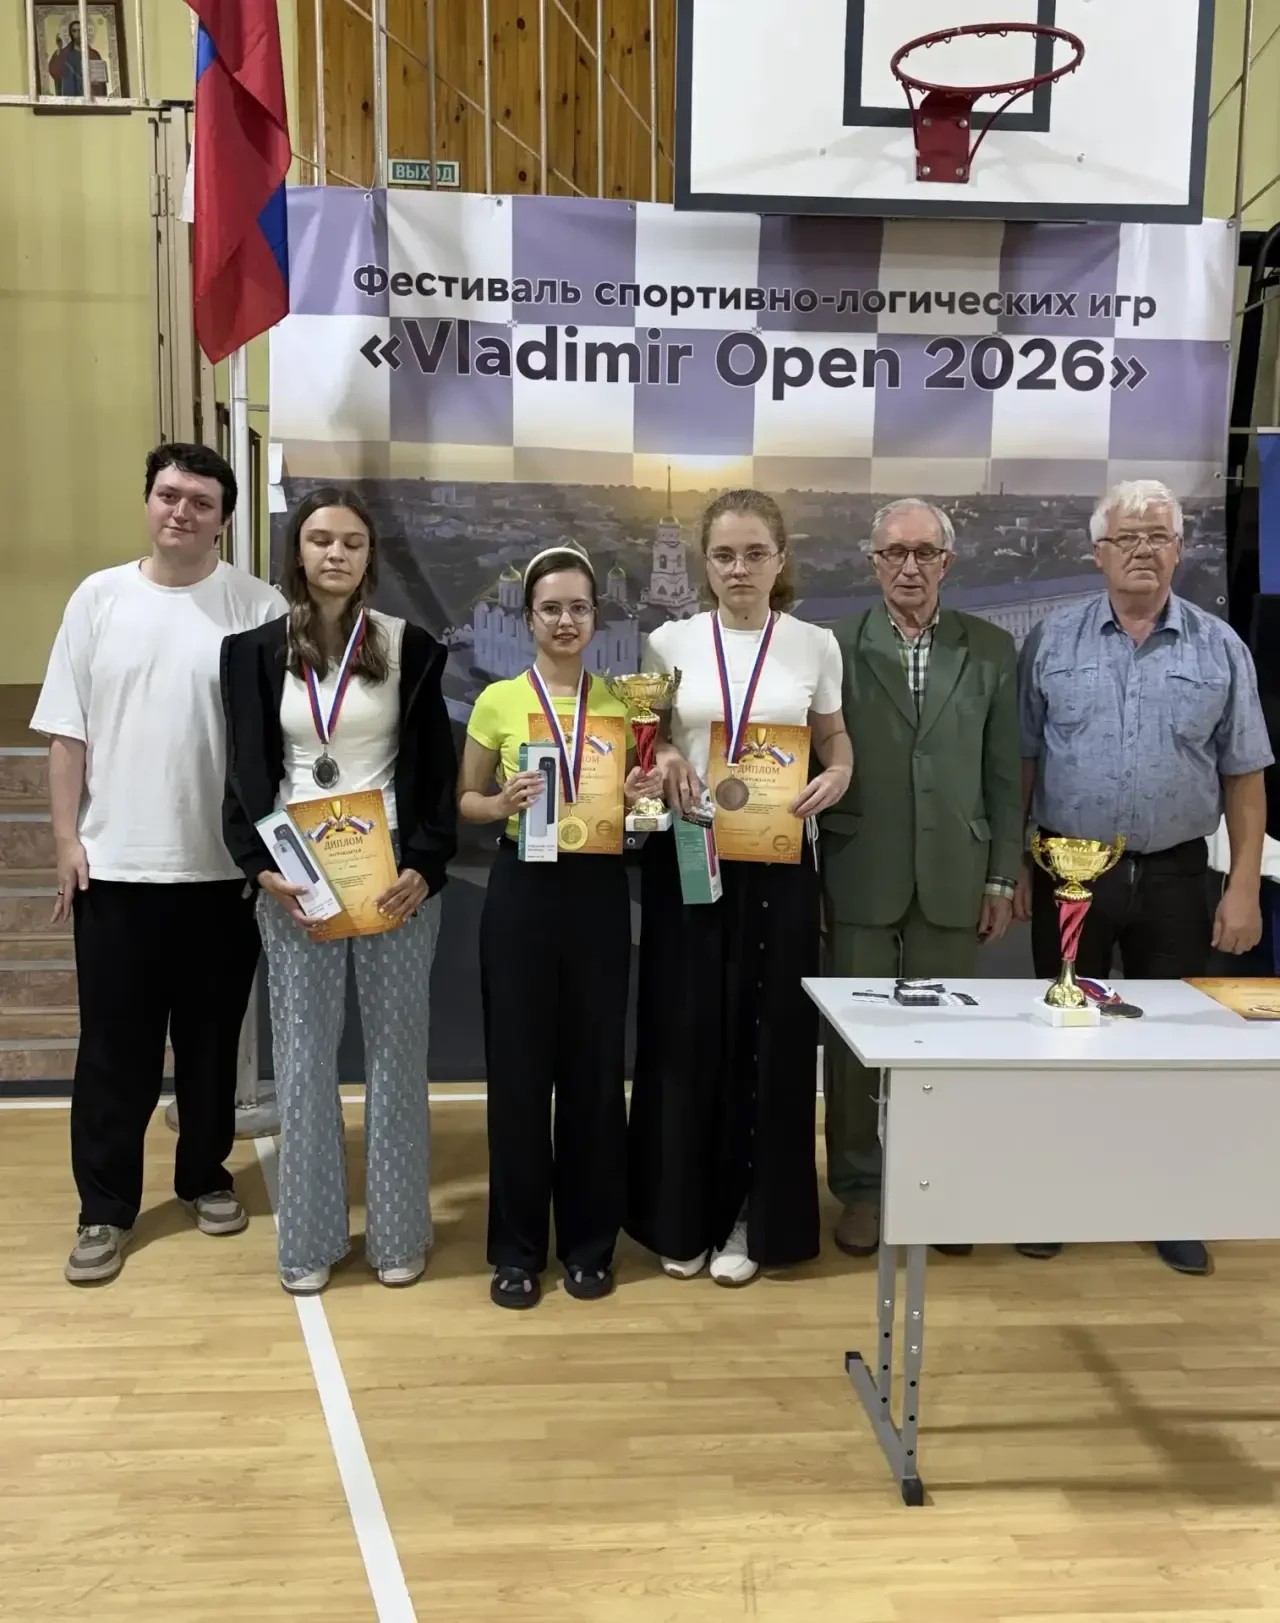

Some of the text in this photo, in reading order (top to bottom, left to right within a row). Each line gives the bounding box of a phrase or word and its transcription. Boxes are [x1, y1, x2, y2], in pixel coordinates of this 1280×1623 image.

[352, 263, 1157, 327] Фестиваль спортивно-логических игр
[359, 319, 1149, 401] «Vladimir Open 2026»
[737, 765, 780, 775] ДИПЛОМ
[324, 836, 363, 850] ДИПЛОМ
